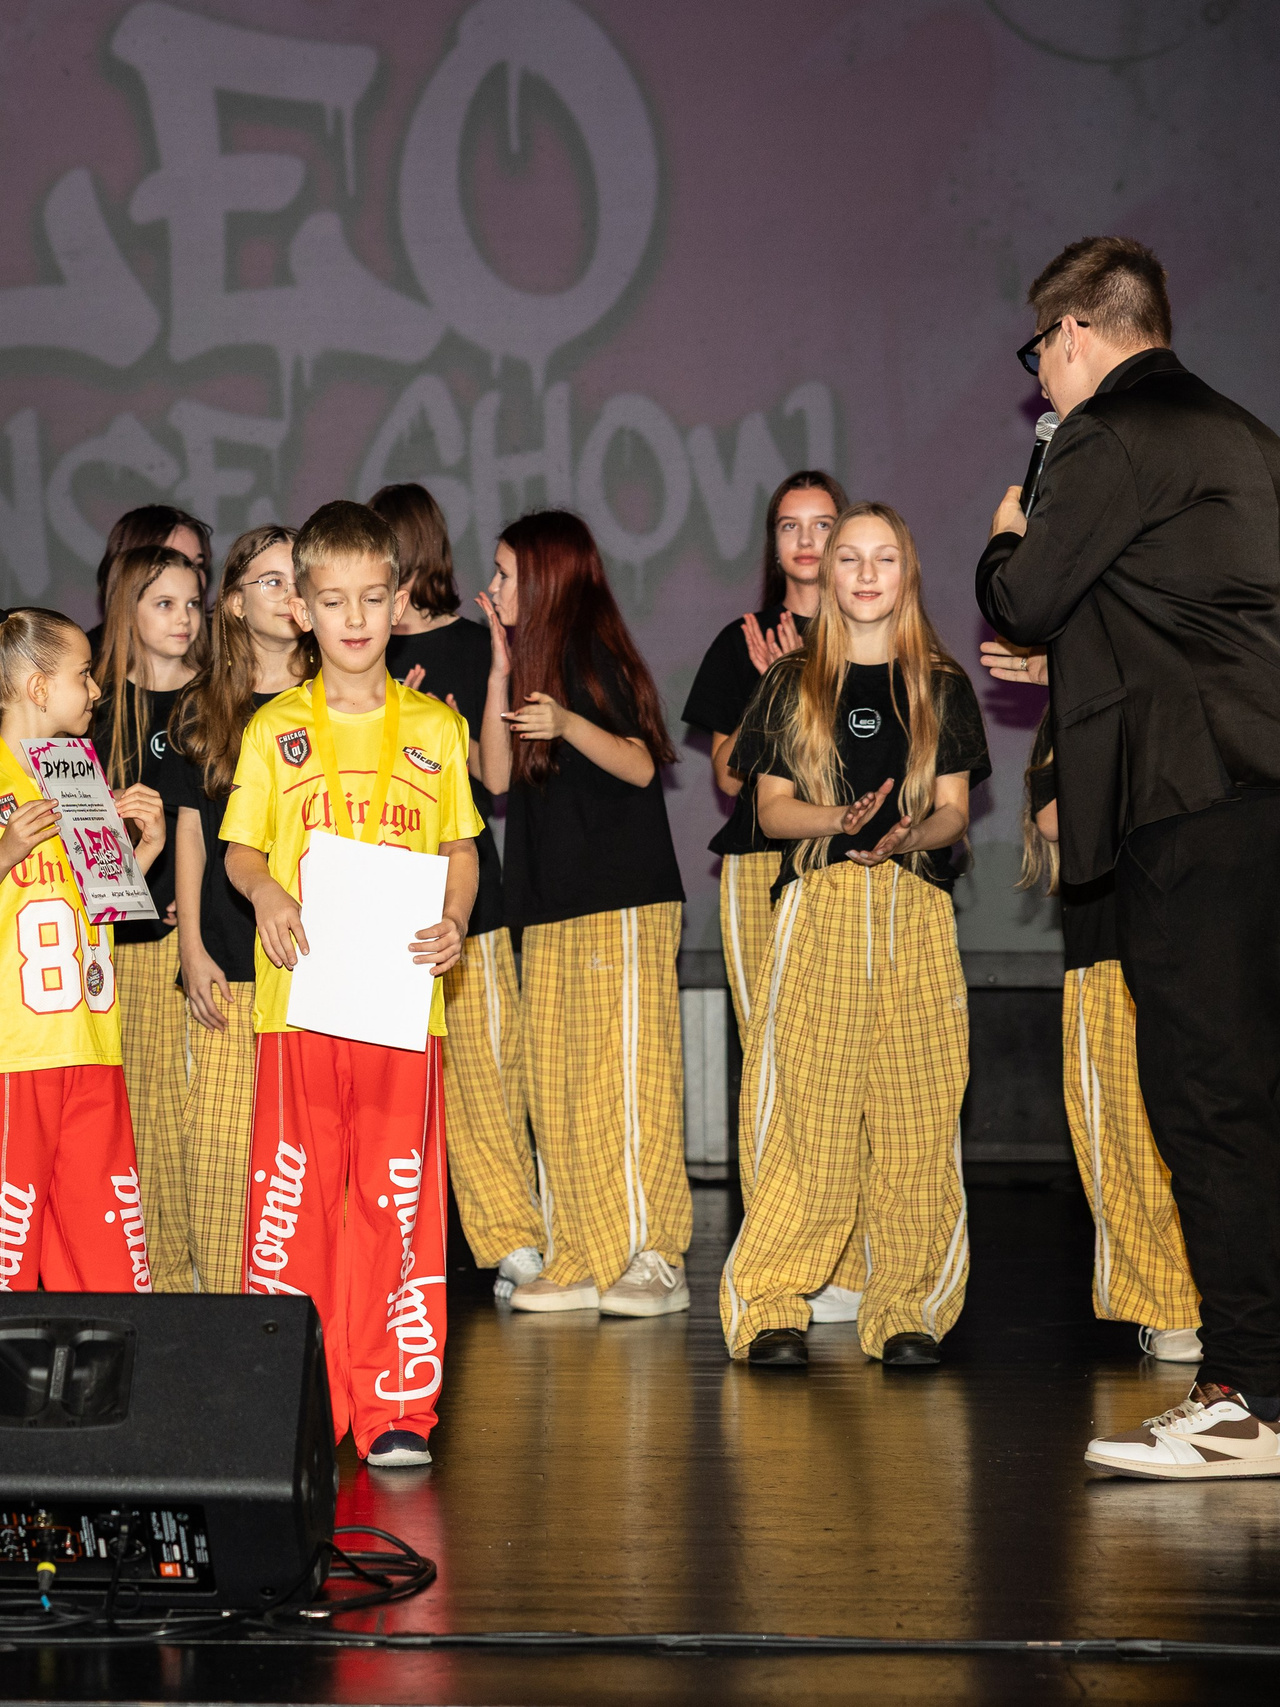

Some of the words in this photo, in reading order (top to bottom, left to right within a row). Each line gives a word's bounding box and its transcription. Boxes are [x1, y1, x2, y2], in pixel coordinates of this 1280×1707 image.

[357, 373, 835, 566] SHOW
[278, 730, 306, 743] CHICAGO
[291, 745, 301, 757] 01
[41, 759, 95, 780] DYPLOM
[73, 826, 122, 870] LEO
